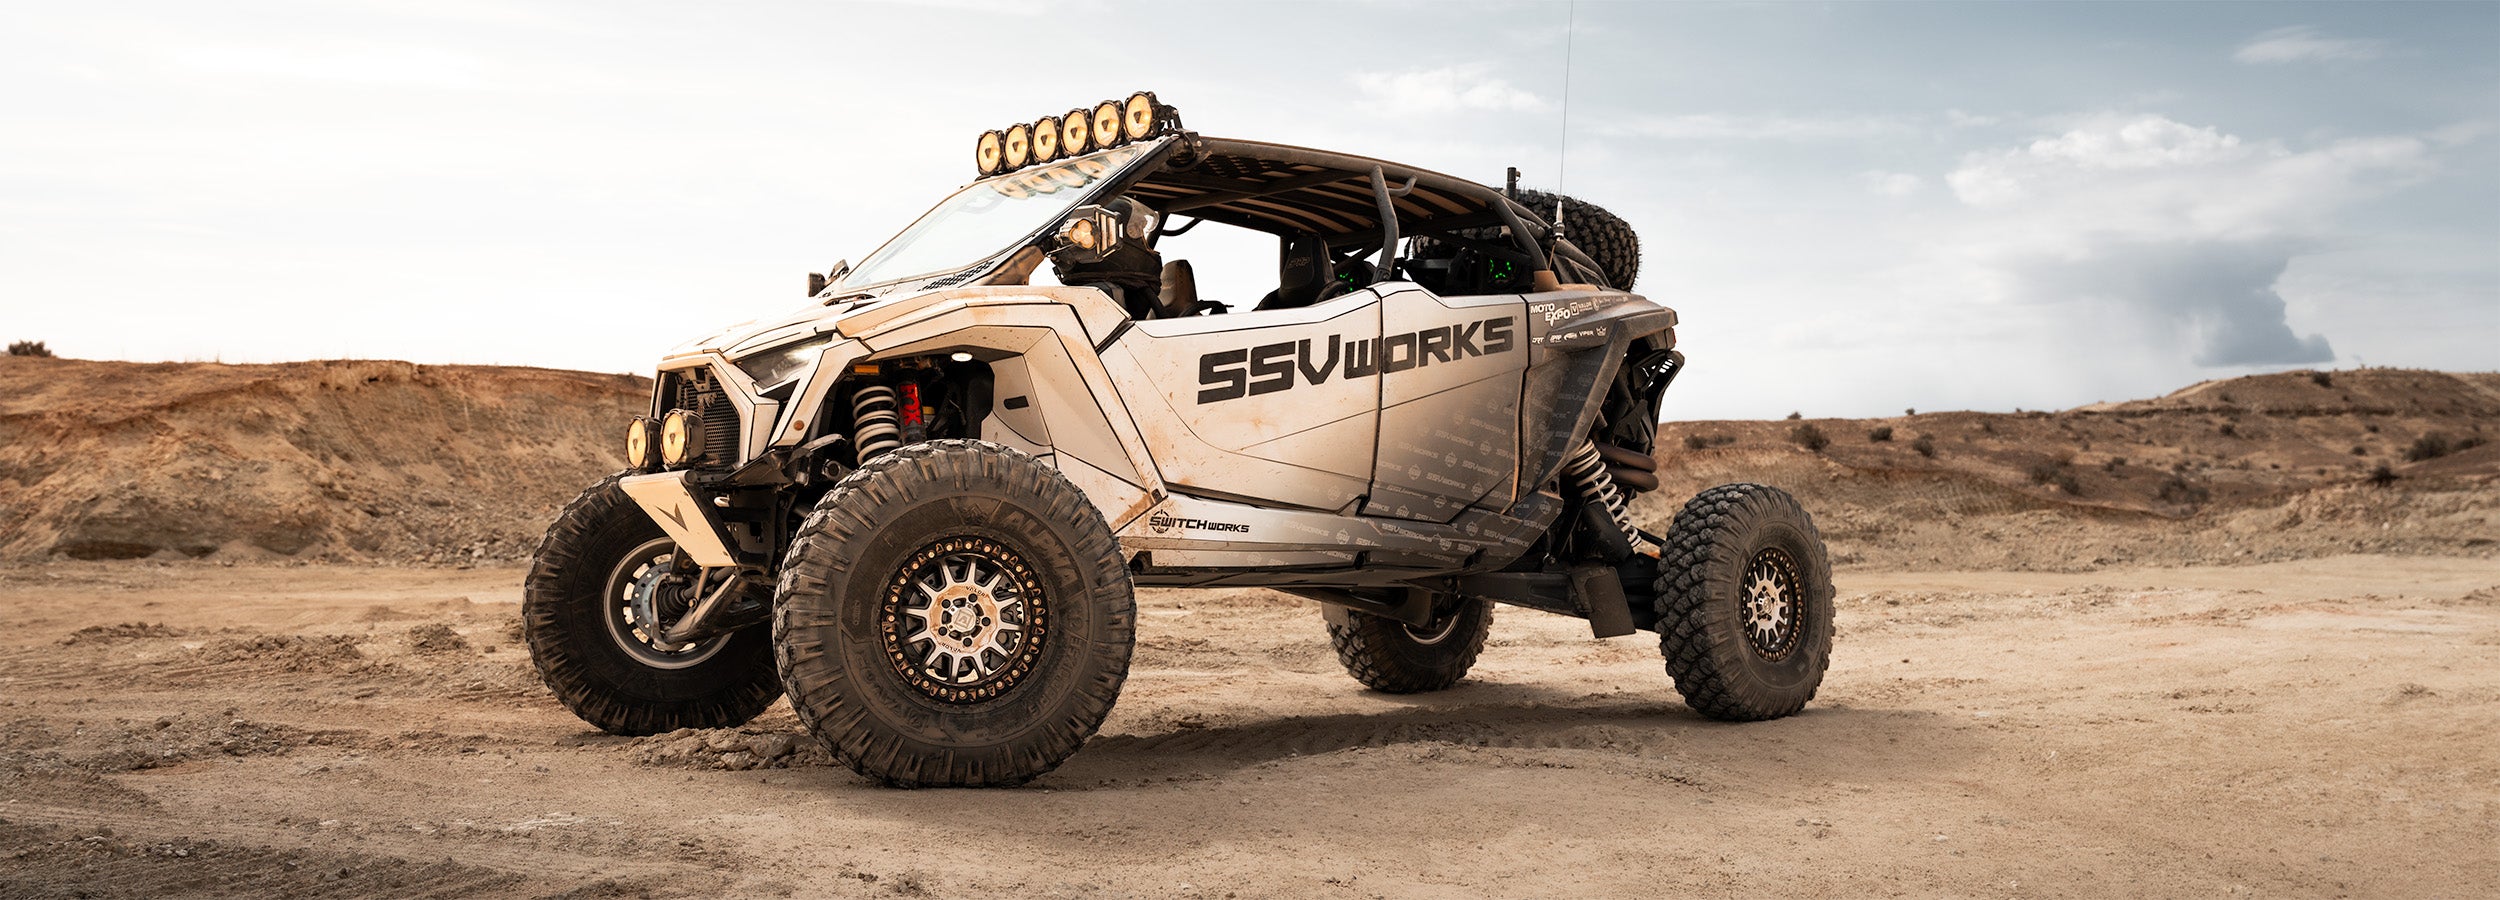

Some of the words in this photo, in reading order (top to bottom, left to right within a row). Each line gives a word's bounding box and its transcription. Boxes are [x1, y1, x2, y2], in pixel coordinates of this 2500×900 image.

[1530, 303, 1555, 314] MOTO
[1545, 308, 1570, 327] EXPO
[1197, 316, 1514, 405] SSVWORKS
[1149, 516, 1250, 533] SWITCHWORKS
